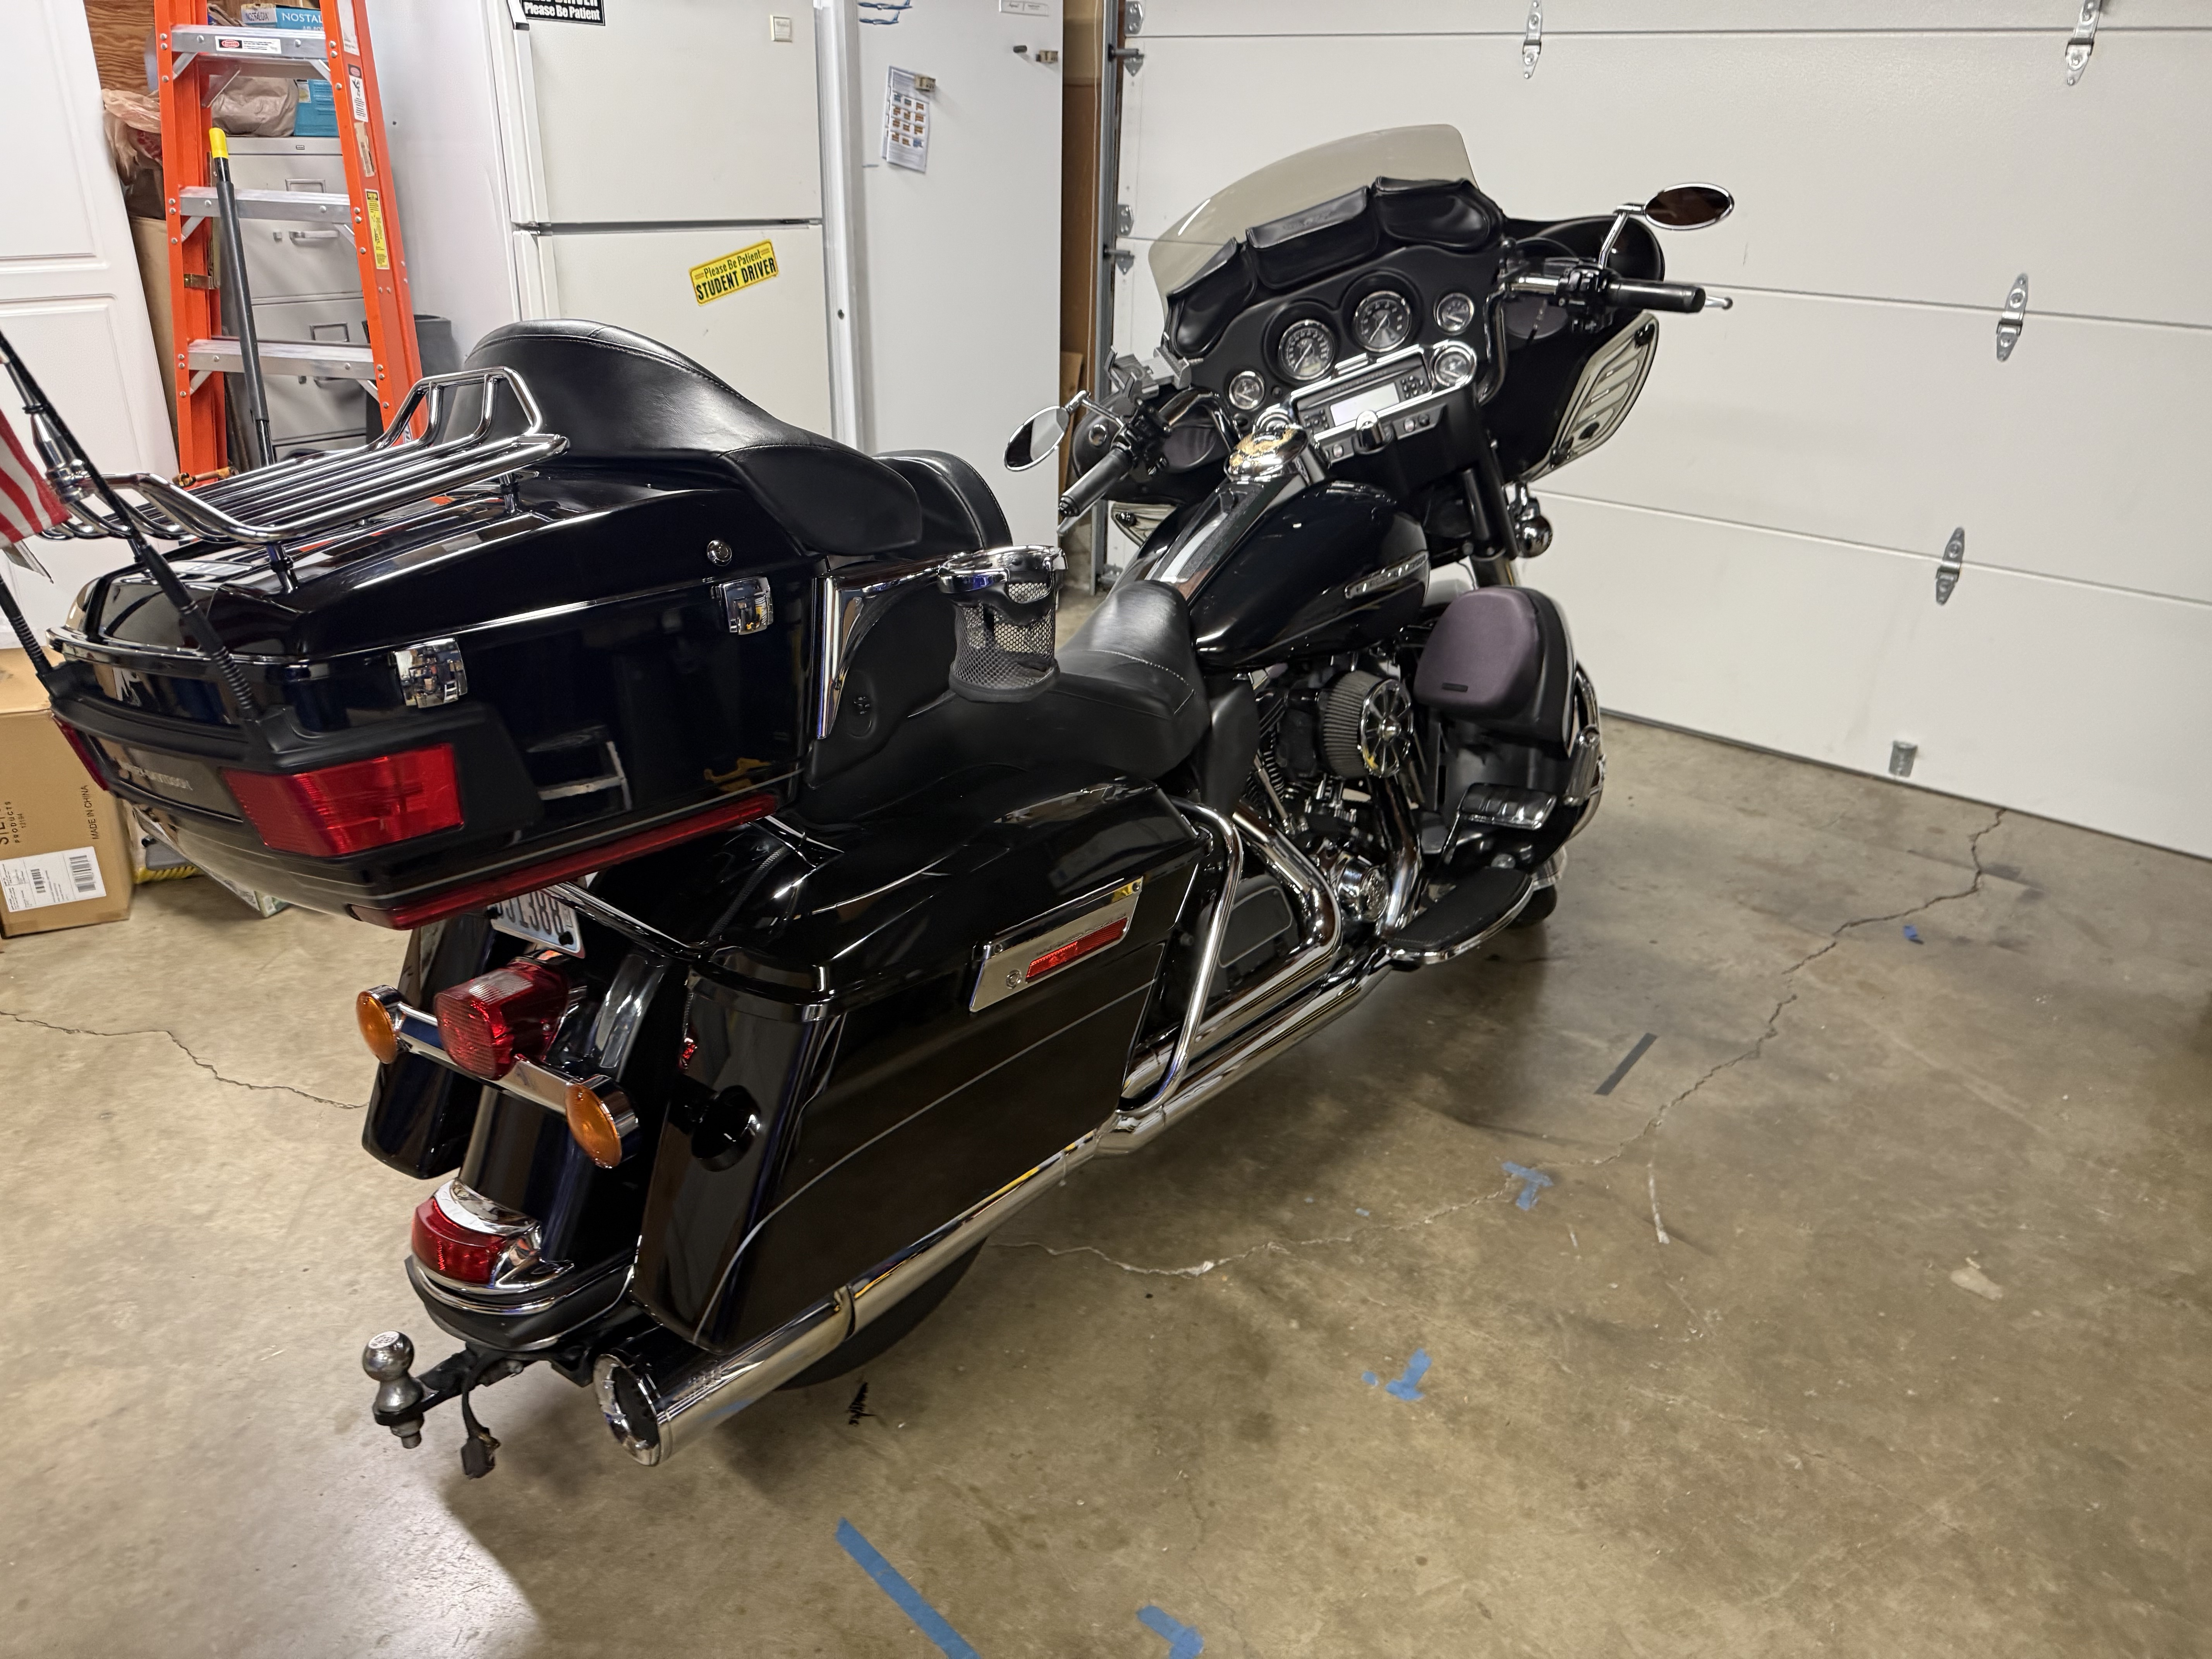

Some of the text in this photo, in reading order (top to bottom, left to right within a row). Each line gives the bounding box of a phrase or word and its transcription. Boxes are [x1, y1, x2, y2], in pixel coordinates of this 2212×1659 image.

[524, 2, 555, 16] Please
[555, 4, 568, 17] Be
[568, 6, 601, 20] Patient
[704, 249, 762, 279] Please Be Patient
[696, 257, 776, 301] STUDENT DRIVER
[80, 785, 92, 808] CHINA
[5, 801, 21, 843] PRODUCTS
[88, 818, 100, 840] MADE
